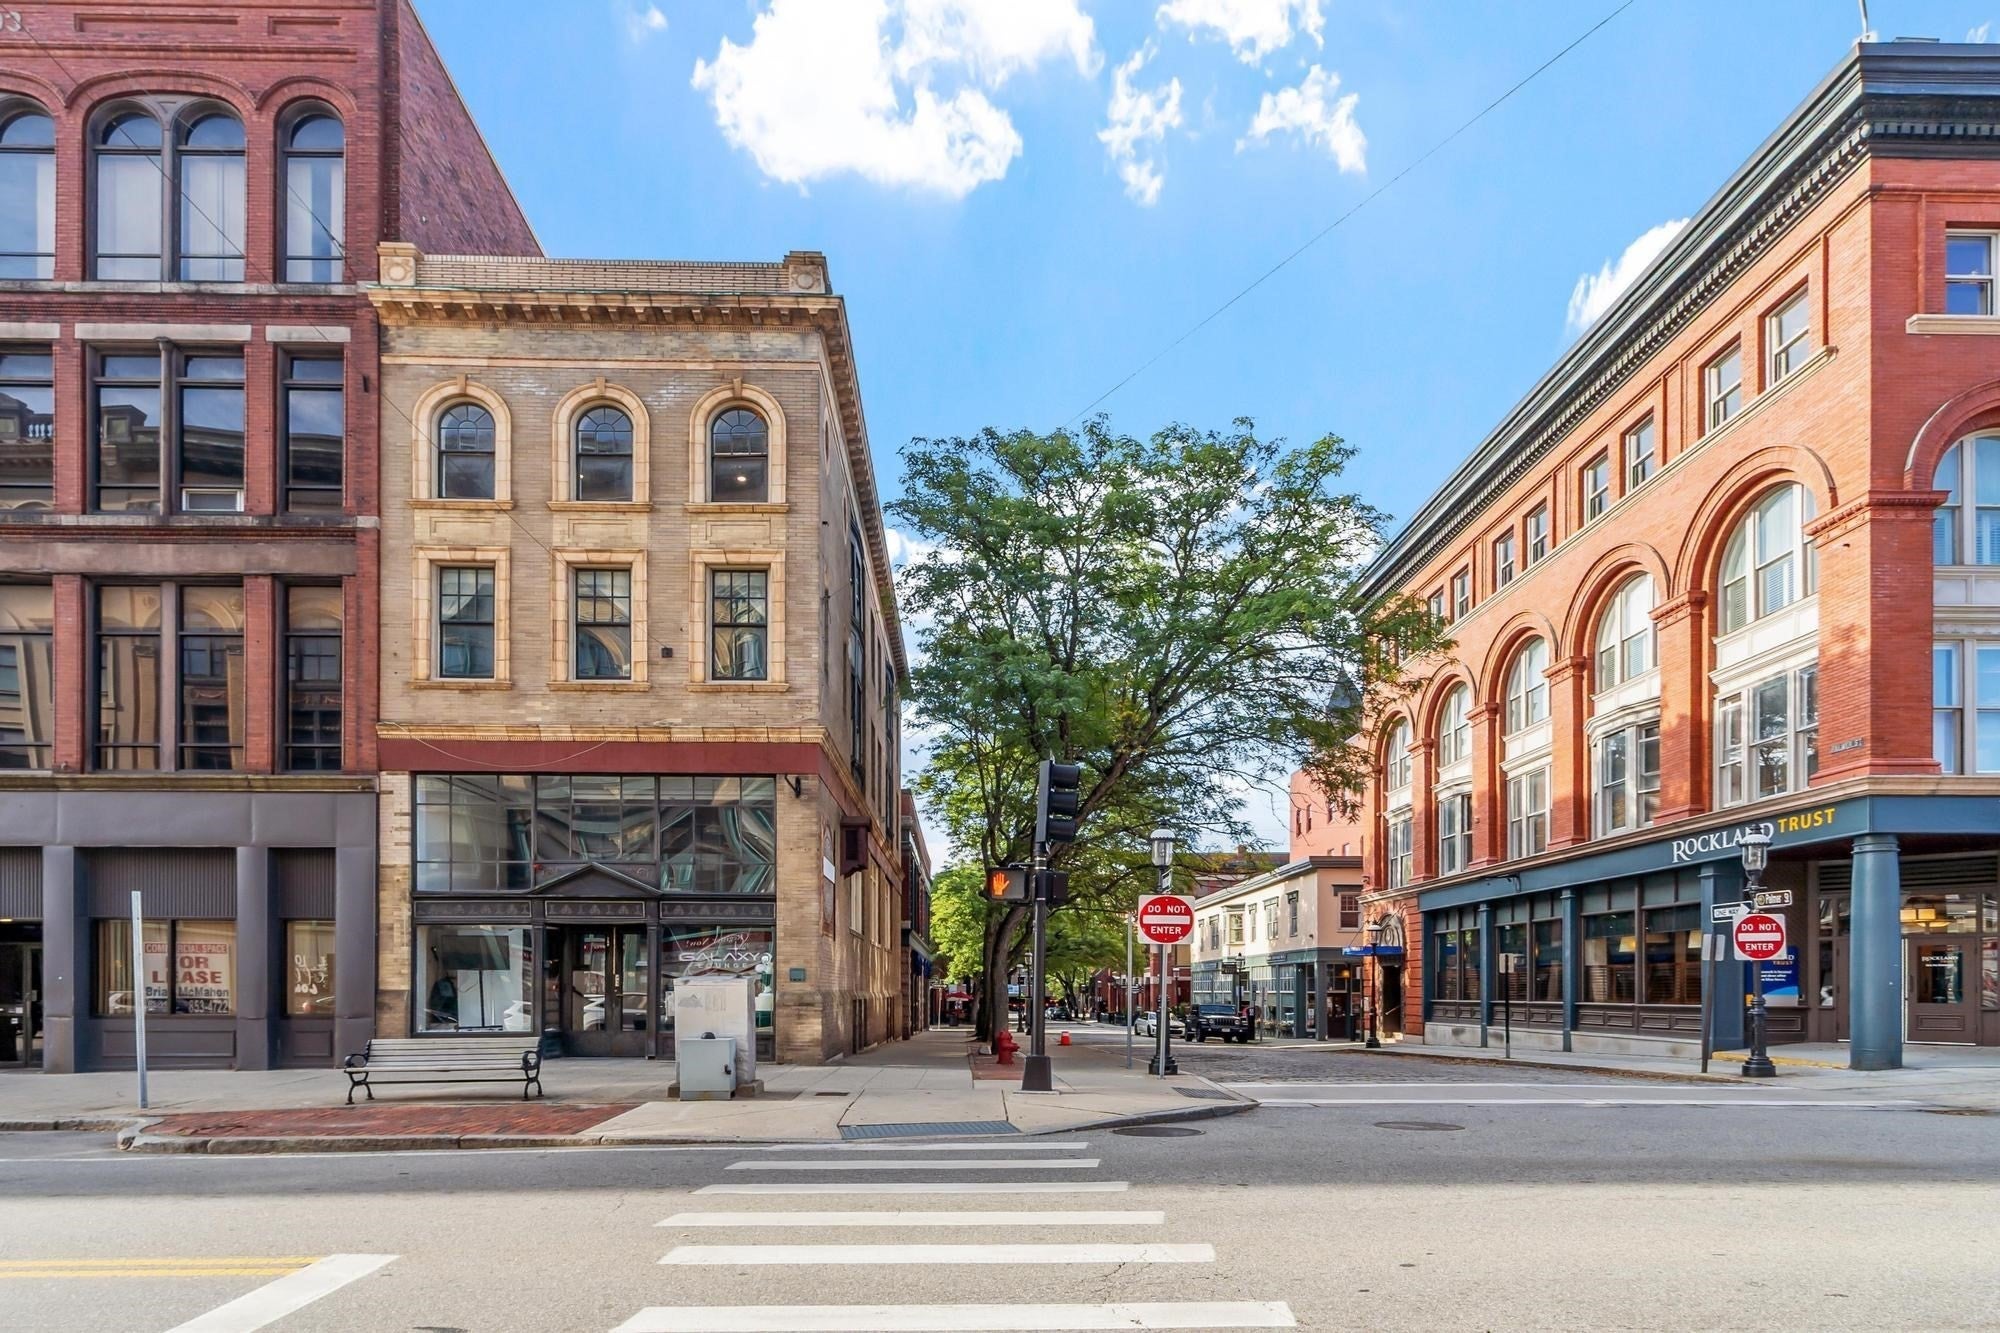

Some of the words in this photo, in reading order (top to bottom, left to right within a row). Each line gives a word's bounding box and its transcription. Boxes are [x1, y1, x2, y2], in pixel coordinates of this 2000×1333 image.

[0, 11, 21, 32] 3
[1672, 823, 1774, 863] ROCKLAD
[1777, 808, 1835, 833] TRUST
[1148, 905, 1161, 913] DO
[1167, 905, 1186, 913] NOT
[1715, 909, 1727, 917] ONE
[1150, 926, 1181, 935] ENTER
[1741, 923, 1753, 931] DO
[1759, 923, 1777, 931] NOT
[202, 944, 226, 953] SPACE
[1745, 943, 1774, 951] ENTER
[678, 952, 760, 961] GALAXY
[152, 971, 222, 984] LASE
[145, 986, 169, 997] Bria
[178, 986, 229, 997] McMahon
[188, 1000, 229, 1013] 853-4722
